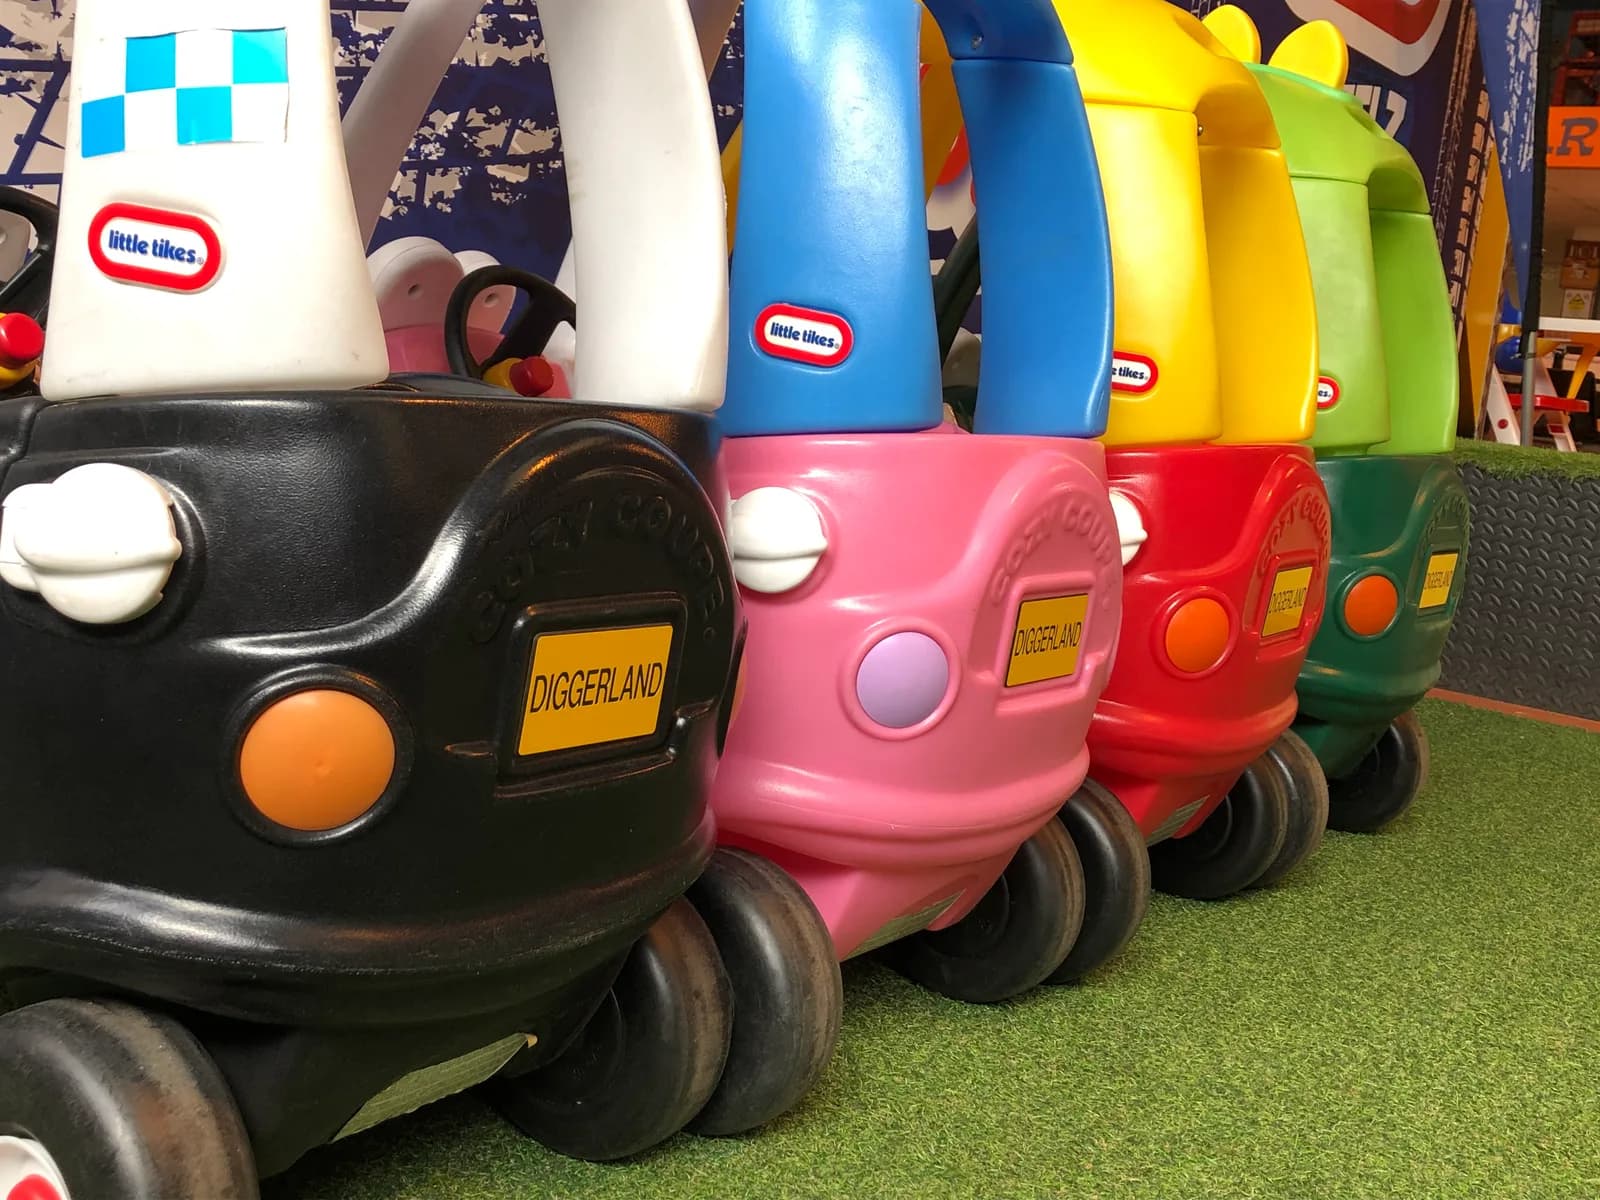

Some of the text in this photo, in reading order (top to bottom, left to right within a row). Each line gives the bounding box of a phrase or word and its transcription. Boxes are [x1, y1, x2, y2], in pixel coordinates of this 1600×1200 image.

[108, 229, 148, 255] little
[770, 322, 800, 341] little
[1119, 366, 1145, 380] tikes
[1014, 622, 1082, 656] DIGGERLAND
[529, 662, 662, 713] DIGGERLAND
